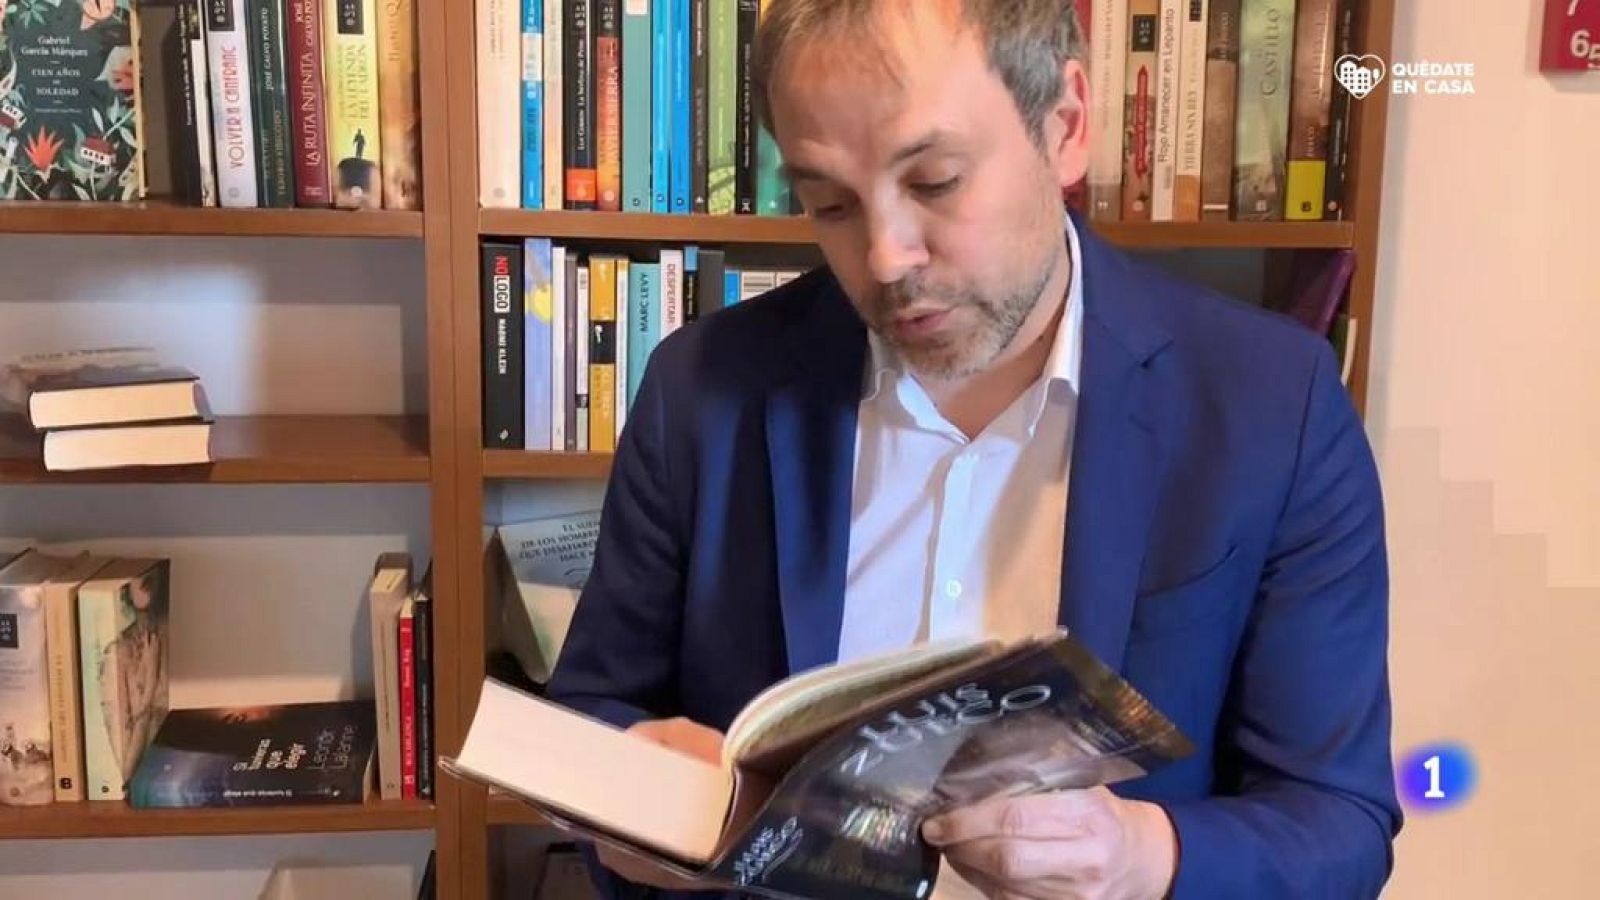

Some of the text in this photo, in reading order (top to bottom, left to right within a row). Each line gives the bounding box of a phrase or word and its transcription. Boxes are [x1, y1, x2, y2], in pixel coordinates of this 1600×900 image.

[1162, 8, 1176, 57] Lepanto
[1261, 6, 1281, 96] CASTILLO
[222, 46, 240, 102] CANFRANC
[1163, 58, 1173, 73] en
[300, 51, 321, 167] LA RUTA INFINITA
[1159, 77, 1171, 135] Amanecer
[226, 116, 246, 170] VOLVER
[1157, 136, 1170, 163] Rojo
[494, 256, 508, 275] NO
[496, 277, 509, 311] LOGO
[639, 272, 650, 332] MARC LEVY
[667, 263, 676, 324] DESPERTAR
